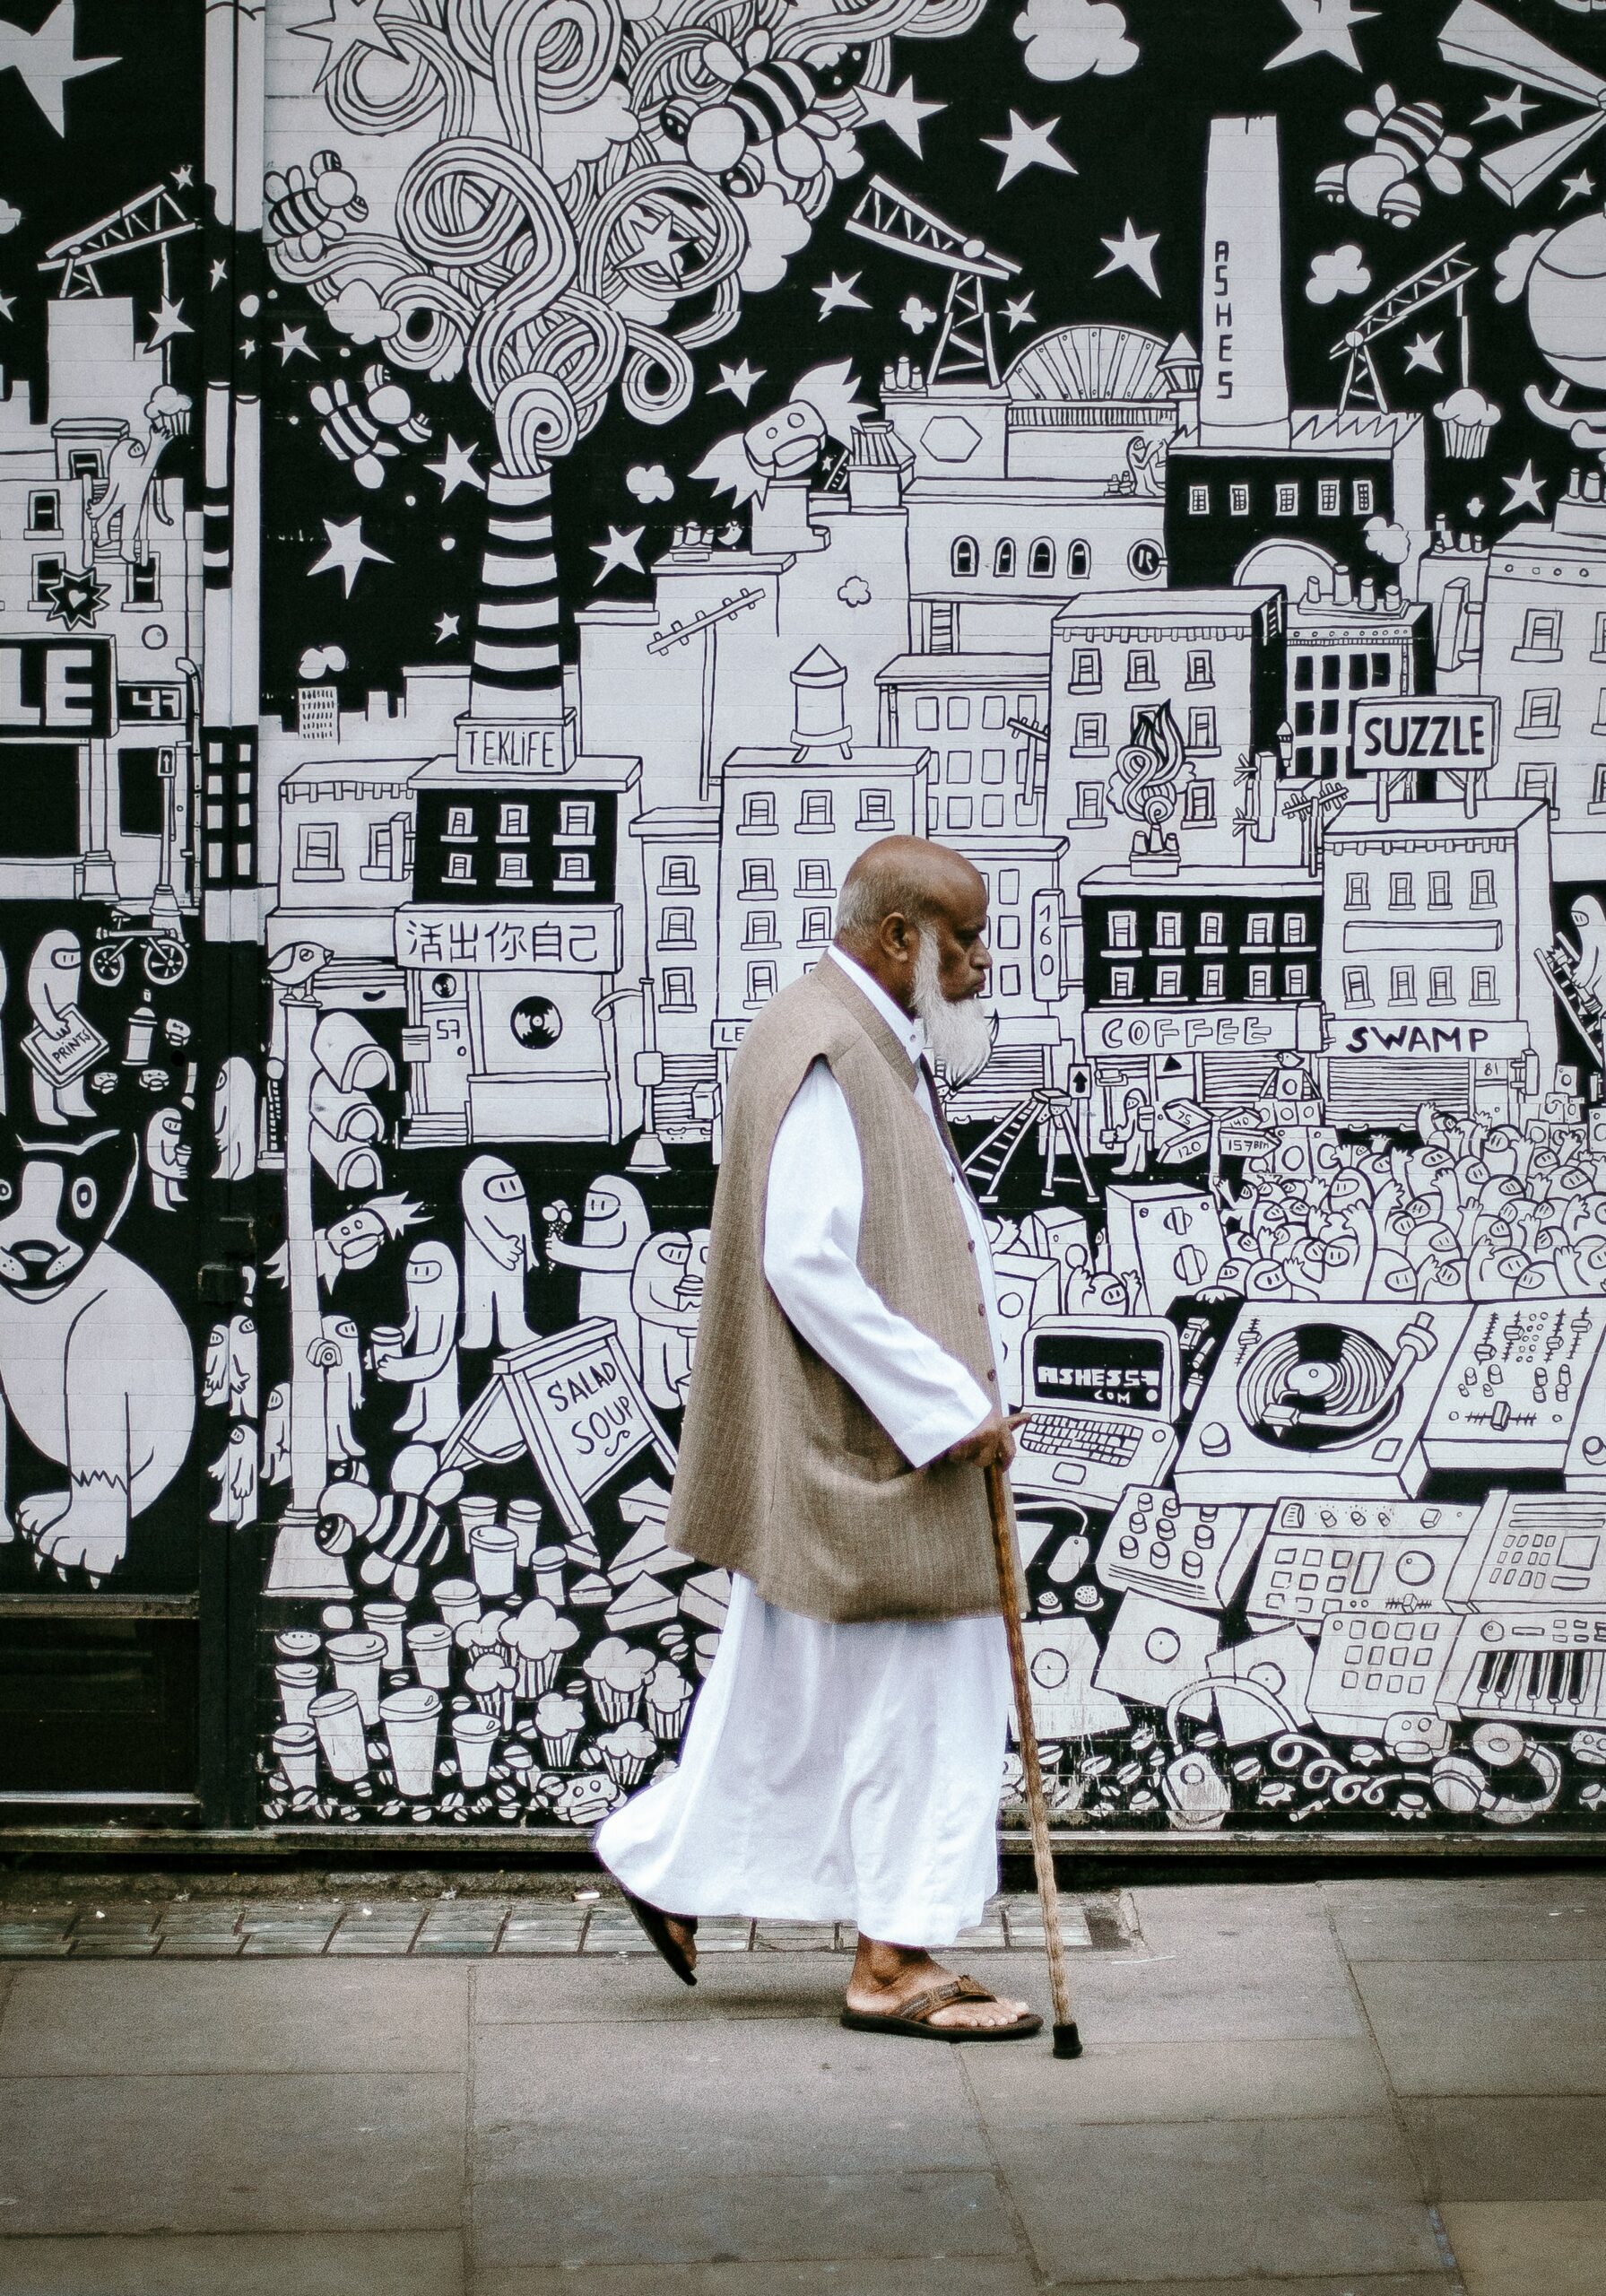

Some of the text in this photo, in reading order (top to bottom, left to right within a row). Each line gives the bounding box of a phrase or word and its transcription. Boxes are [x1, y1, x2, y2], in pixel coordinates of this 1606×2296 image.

[1214, 240, 1233, 399] ASHES
[1364, 716, 1485, 757] SUZZLE
[406, 920, 598, 963] 活出你自己
[1039, 904, 1054, 976] 160
[1102, 1016, 1272, 1048] COFFEE
[1345, 1025, 1489, 1053] SWAMP
[1484, 1062, 1498, 1076] 81
[1176, 1110, 1192, 1126] 75
[1177, 1141, 1202, 1159] 120
[547, 1361, 616, 1412] SALAD
[571, 1396, 633, 1455] SOUP
